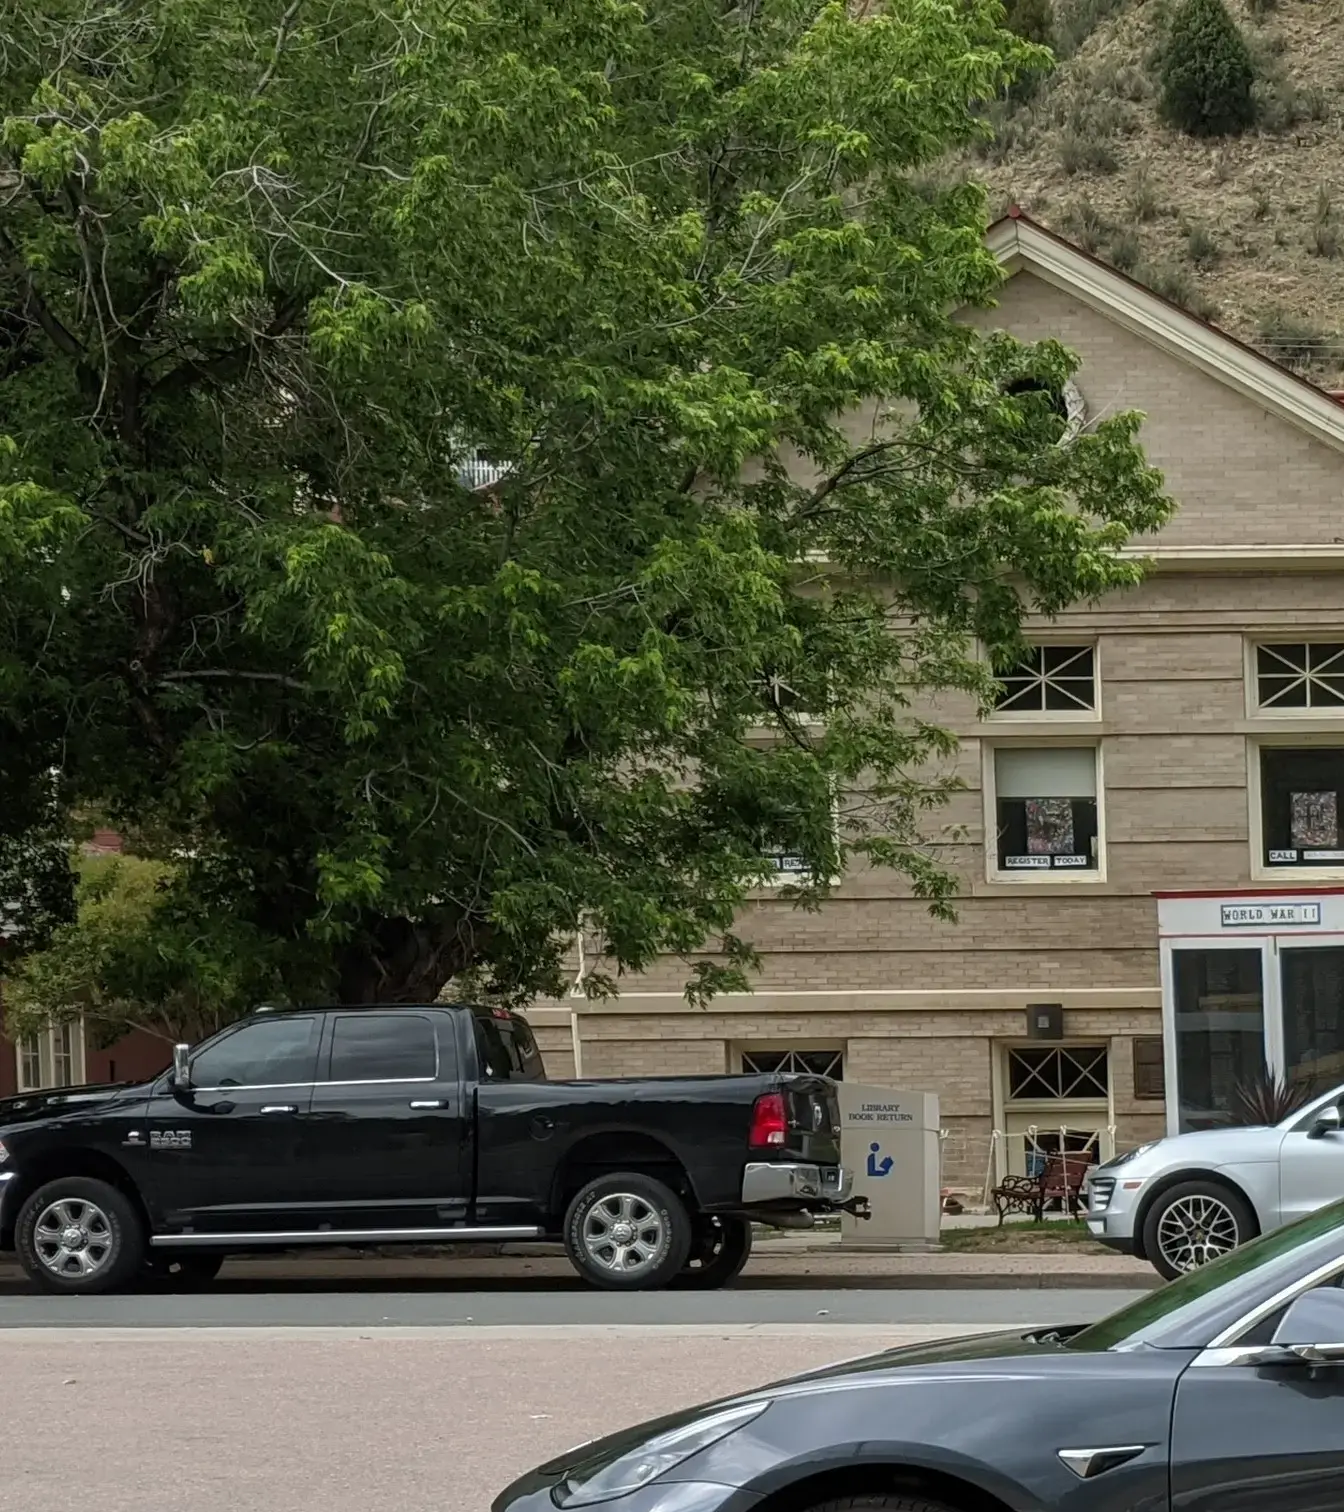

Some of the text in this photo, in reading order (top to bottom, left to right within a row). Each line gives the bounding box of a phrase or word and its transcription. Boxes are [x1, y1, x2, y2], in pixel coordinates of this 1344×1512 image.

[1269, 851, 1295, 860] CALL
[1007, 856, 1085, 866] REGISTER TODAY
[1223, 908, 1316, 921] WORLD WAR II
[861, 1104, 900, 1112] LIBRARY
[848, 1113, 913, 1121] BOOK RETURN
